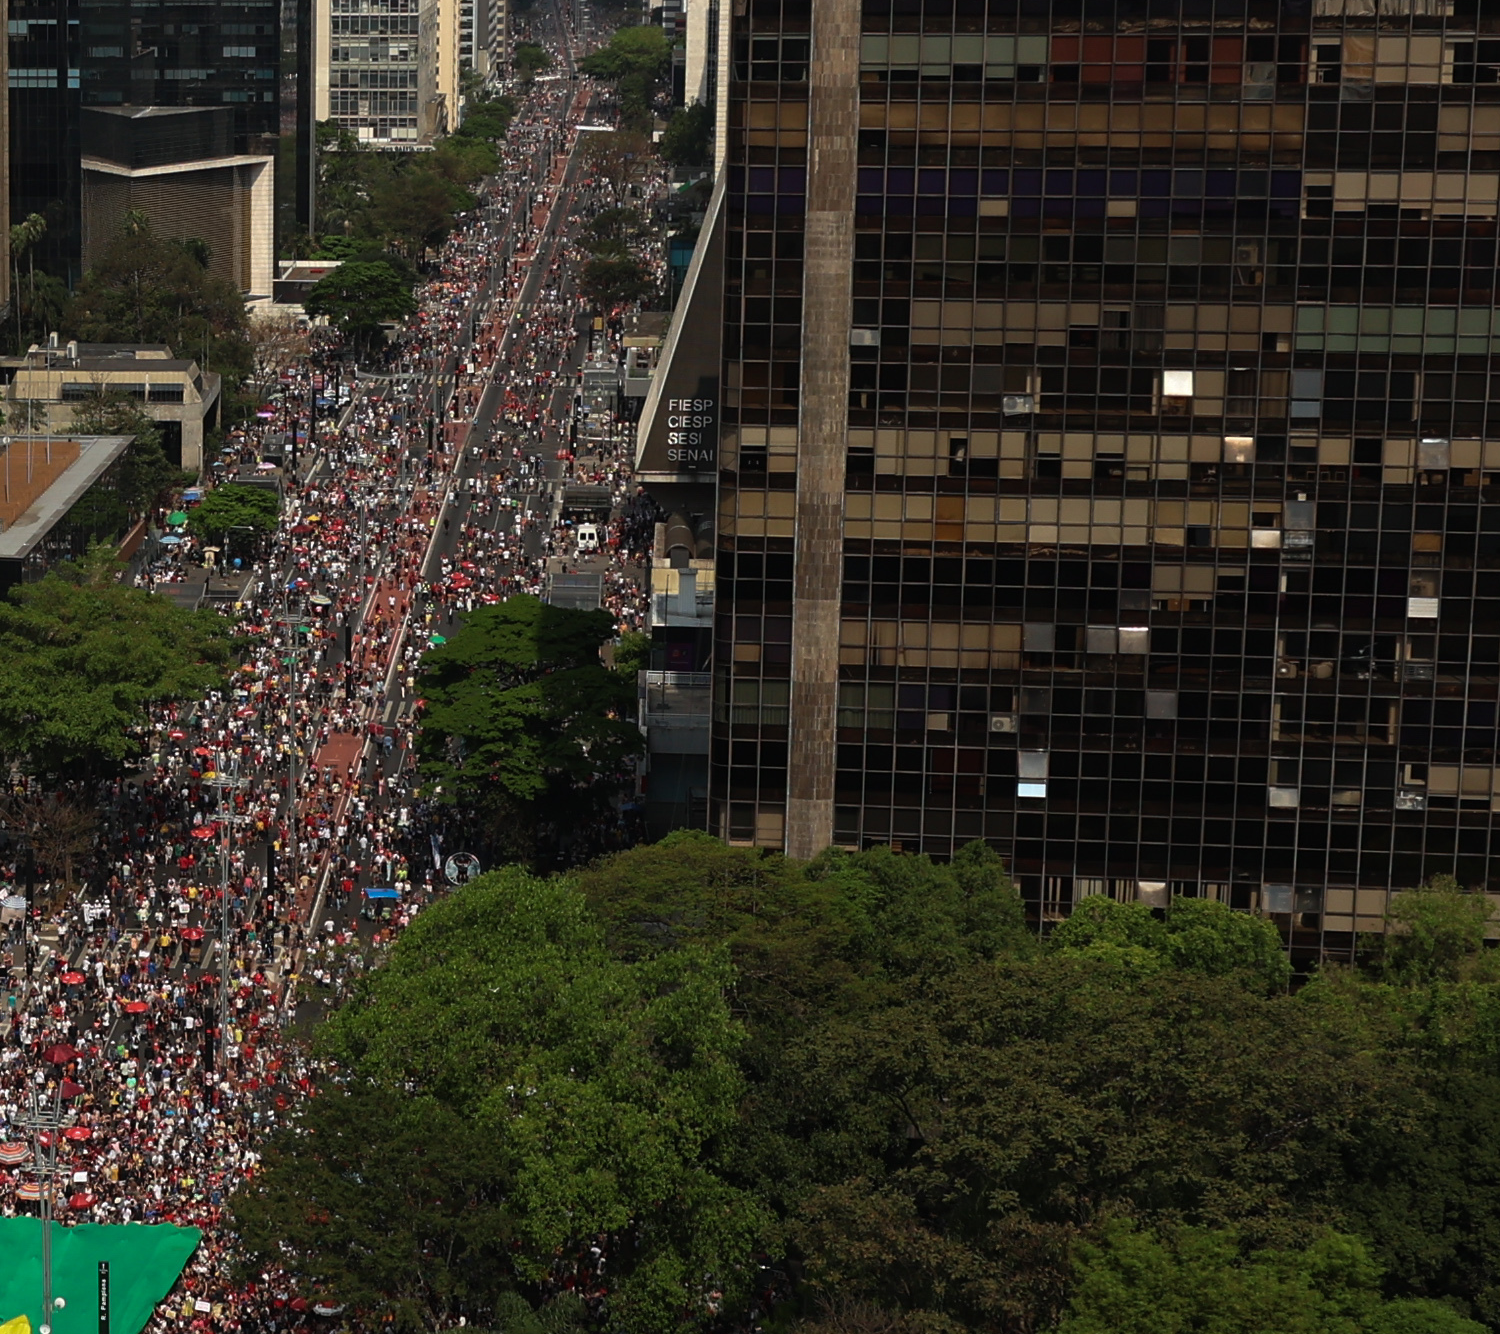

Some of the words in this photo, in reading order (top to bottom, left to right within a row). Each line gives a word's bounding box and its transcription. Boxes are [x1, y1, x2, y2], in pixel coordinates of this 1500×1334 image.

[668, 399, 714, 412] FIESP
[667, 415, 713, 428] CIESP
[667, 432, 702, 445] SESI
[667, 449, 714, 462] SENAI
